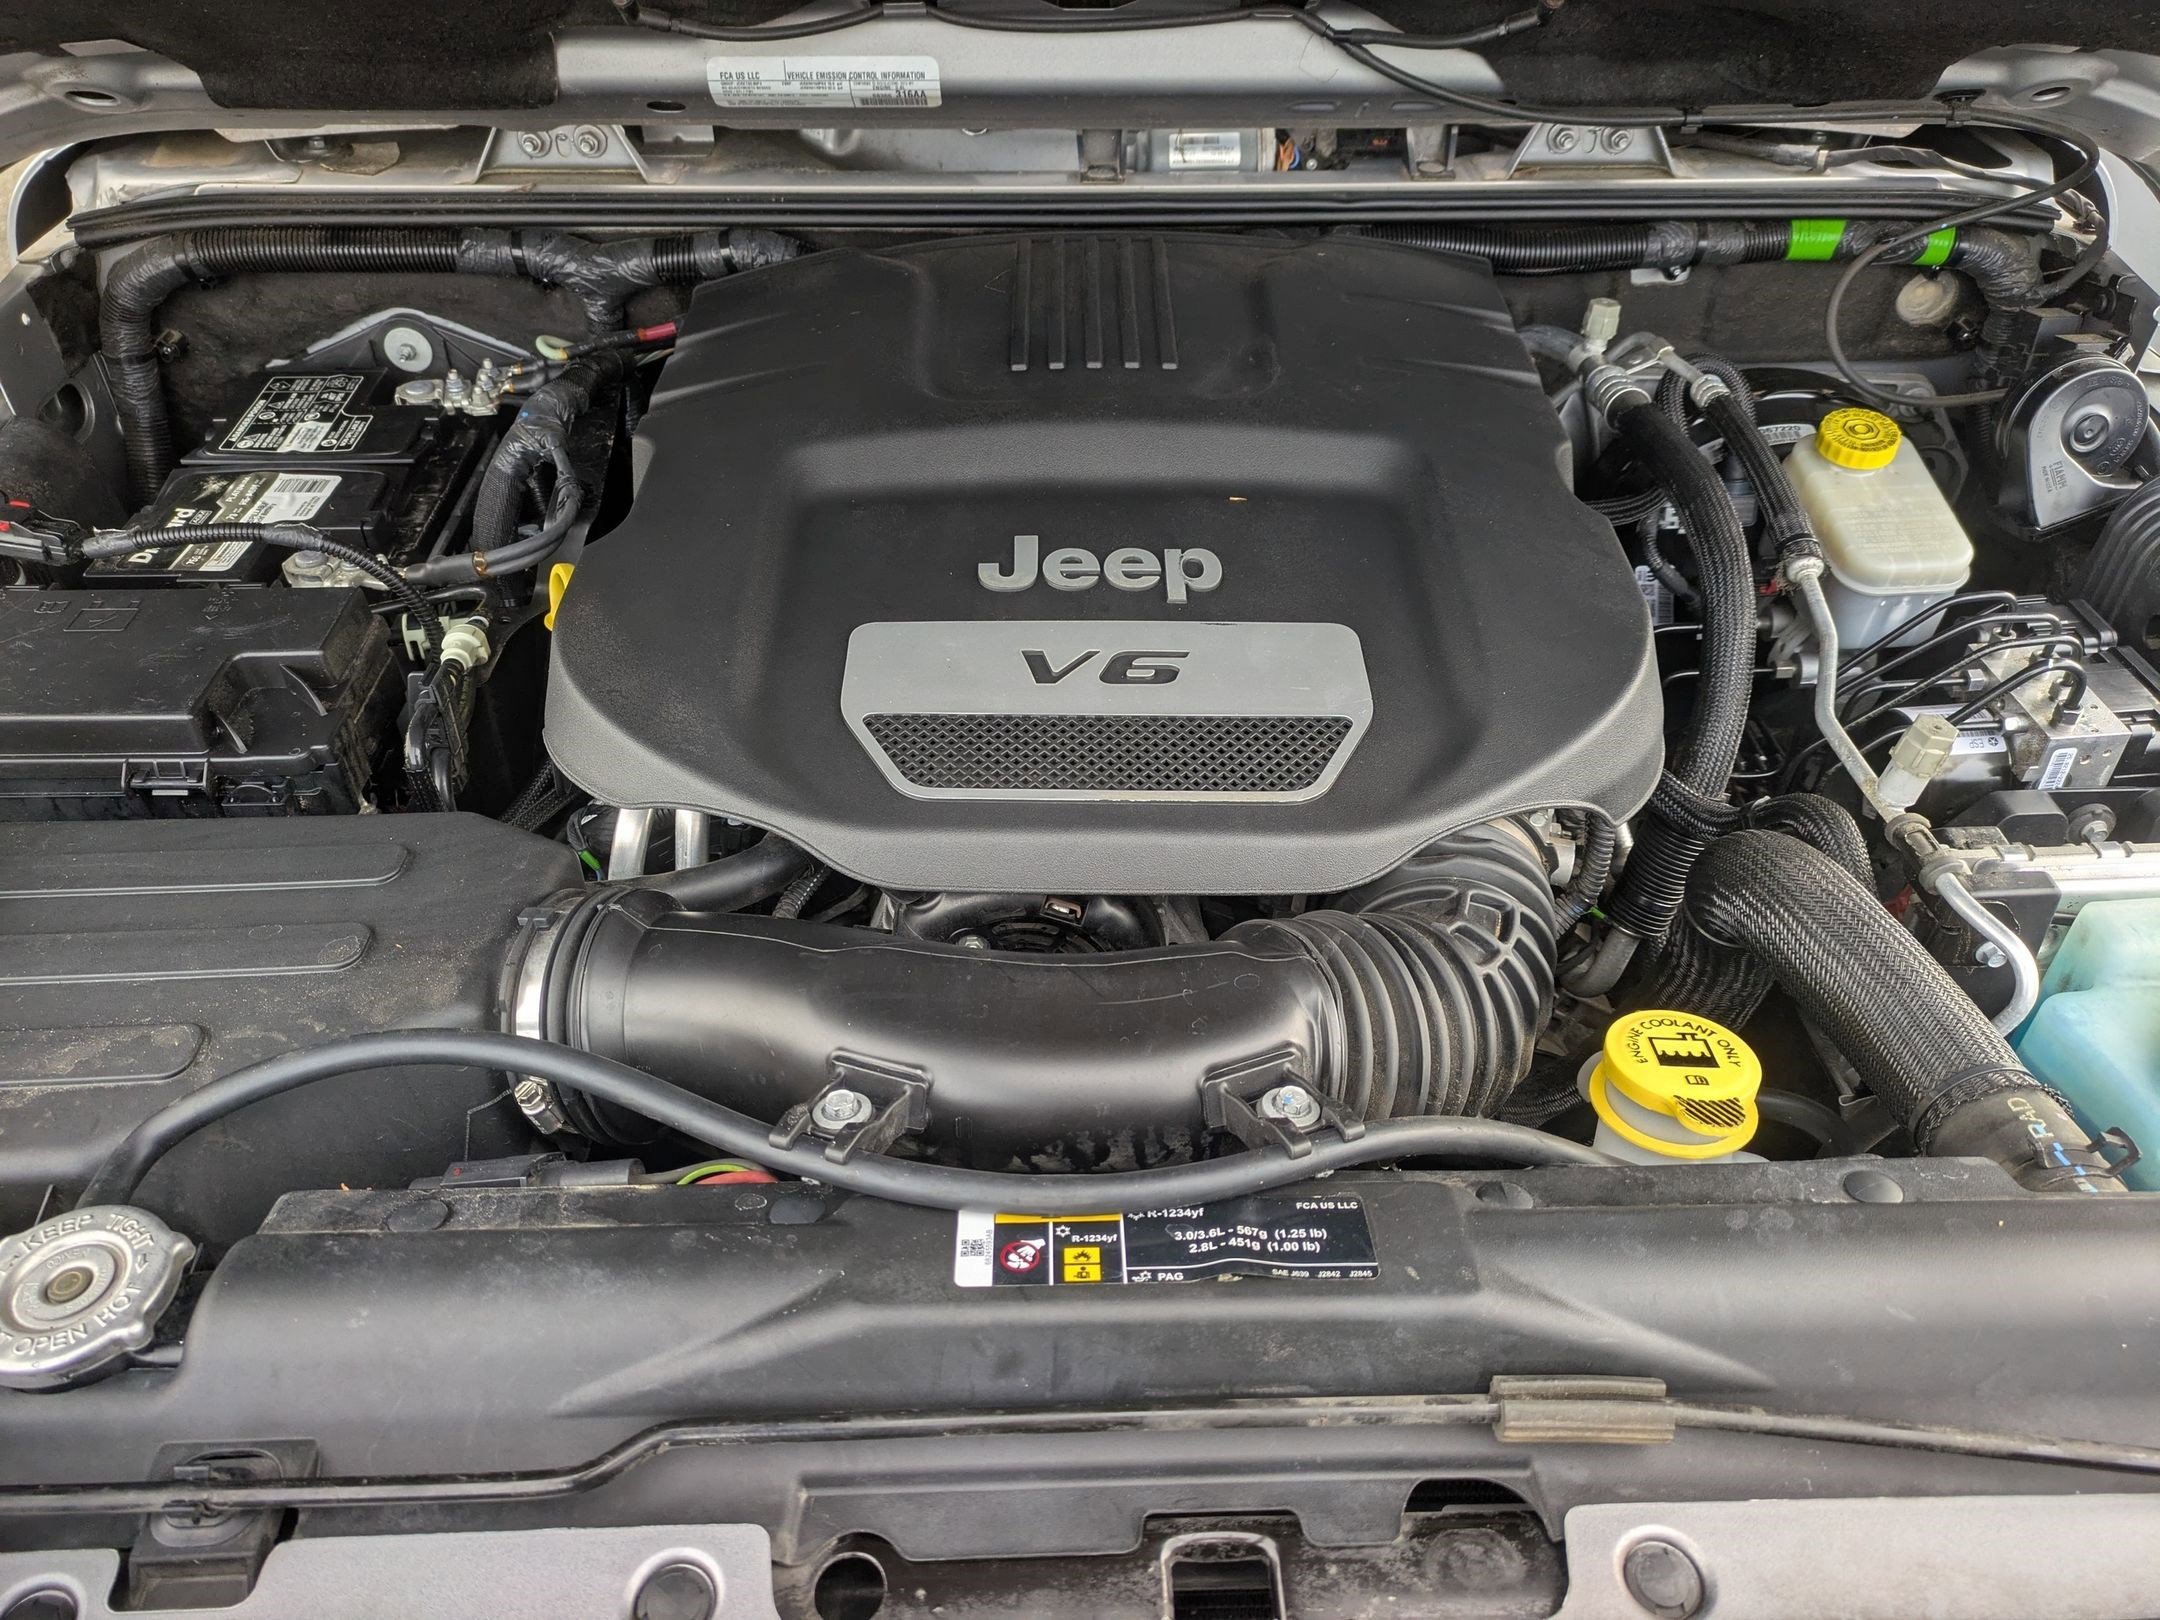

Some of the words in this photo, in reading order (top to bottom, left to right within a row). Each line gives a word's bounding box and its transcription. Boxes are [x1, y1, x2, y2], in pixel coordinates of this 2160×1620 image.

[719, 71, 734, 80] FCA
[735, 71, 746, 80] US
[747, 71, 760, 80] LLC
[786, 71, 814, 80] VEHICLE
[815, 71, 847, 80] EMISSION
[849, 71, 878, 80] CONTROL
[880, 71, 926, 80] INFORMATION
[977, 535, 1223, 604] Jeep
[1020, 649, 1191, 685] V6
[1625, 1027, 1649, 1064] ENGINE
[1640, 1018, 1717, 1037] COOLANT
[1717, 1039, 1742, 1068] ONLY
[1295, 1202, 1319, 1210] FCA
[21, 1213, 94, 1253] KEEP
[105, 1213, 155, 1250] TIGHT
[1071, 1234, 1118, 1244] R-1234yf
[1173, 1227, 1226, 1241] 3.0/3.6L
[1236, 1225, 1268, 1240] 567g
[1274, 1228, 1307, 1240] (1.25
[1309, 1228, 1328, 1240] lb)
[1188, 1241, 1218, 1253] 2.8L
[1228, 1237, 1261, 1251] 451g
[1267, 1241, 1299, 1253] (1.00
[1302, 1241, 1321, 1253] lb)
[1157, 1272, 1184, 1281] PAG
[1272, 1268, 1289, 1277] SAE
[1317, 1270, 1341, 1278] J2842
[12, 1322, 88, 1356] OPEN
[92, 1282, 142, 1328] HOT
